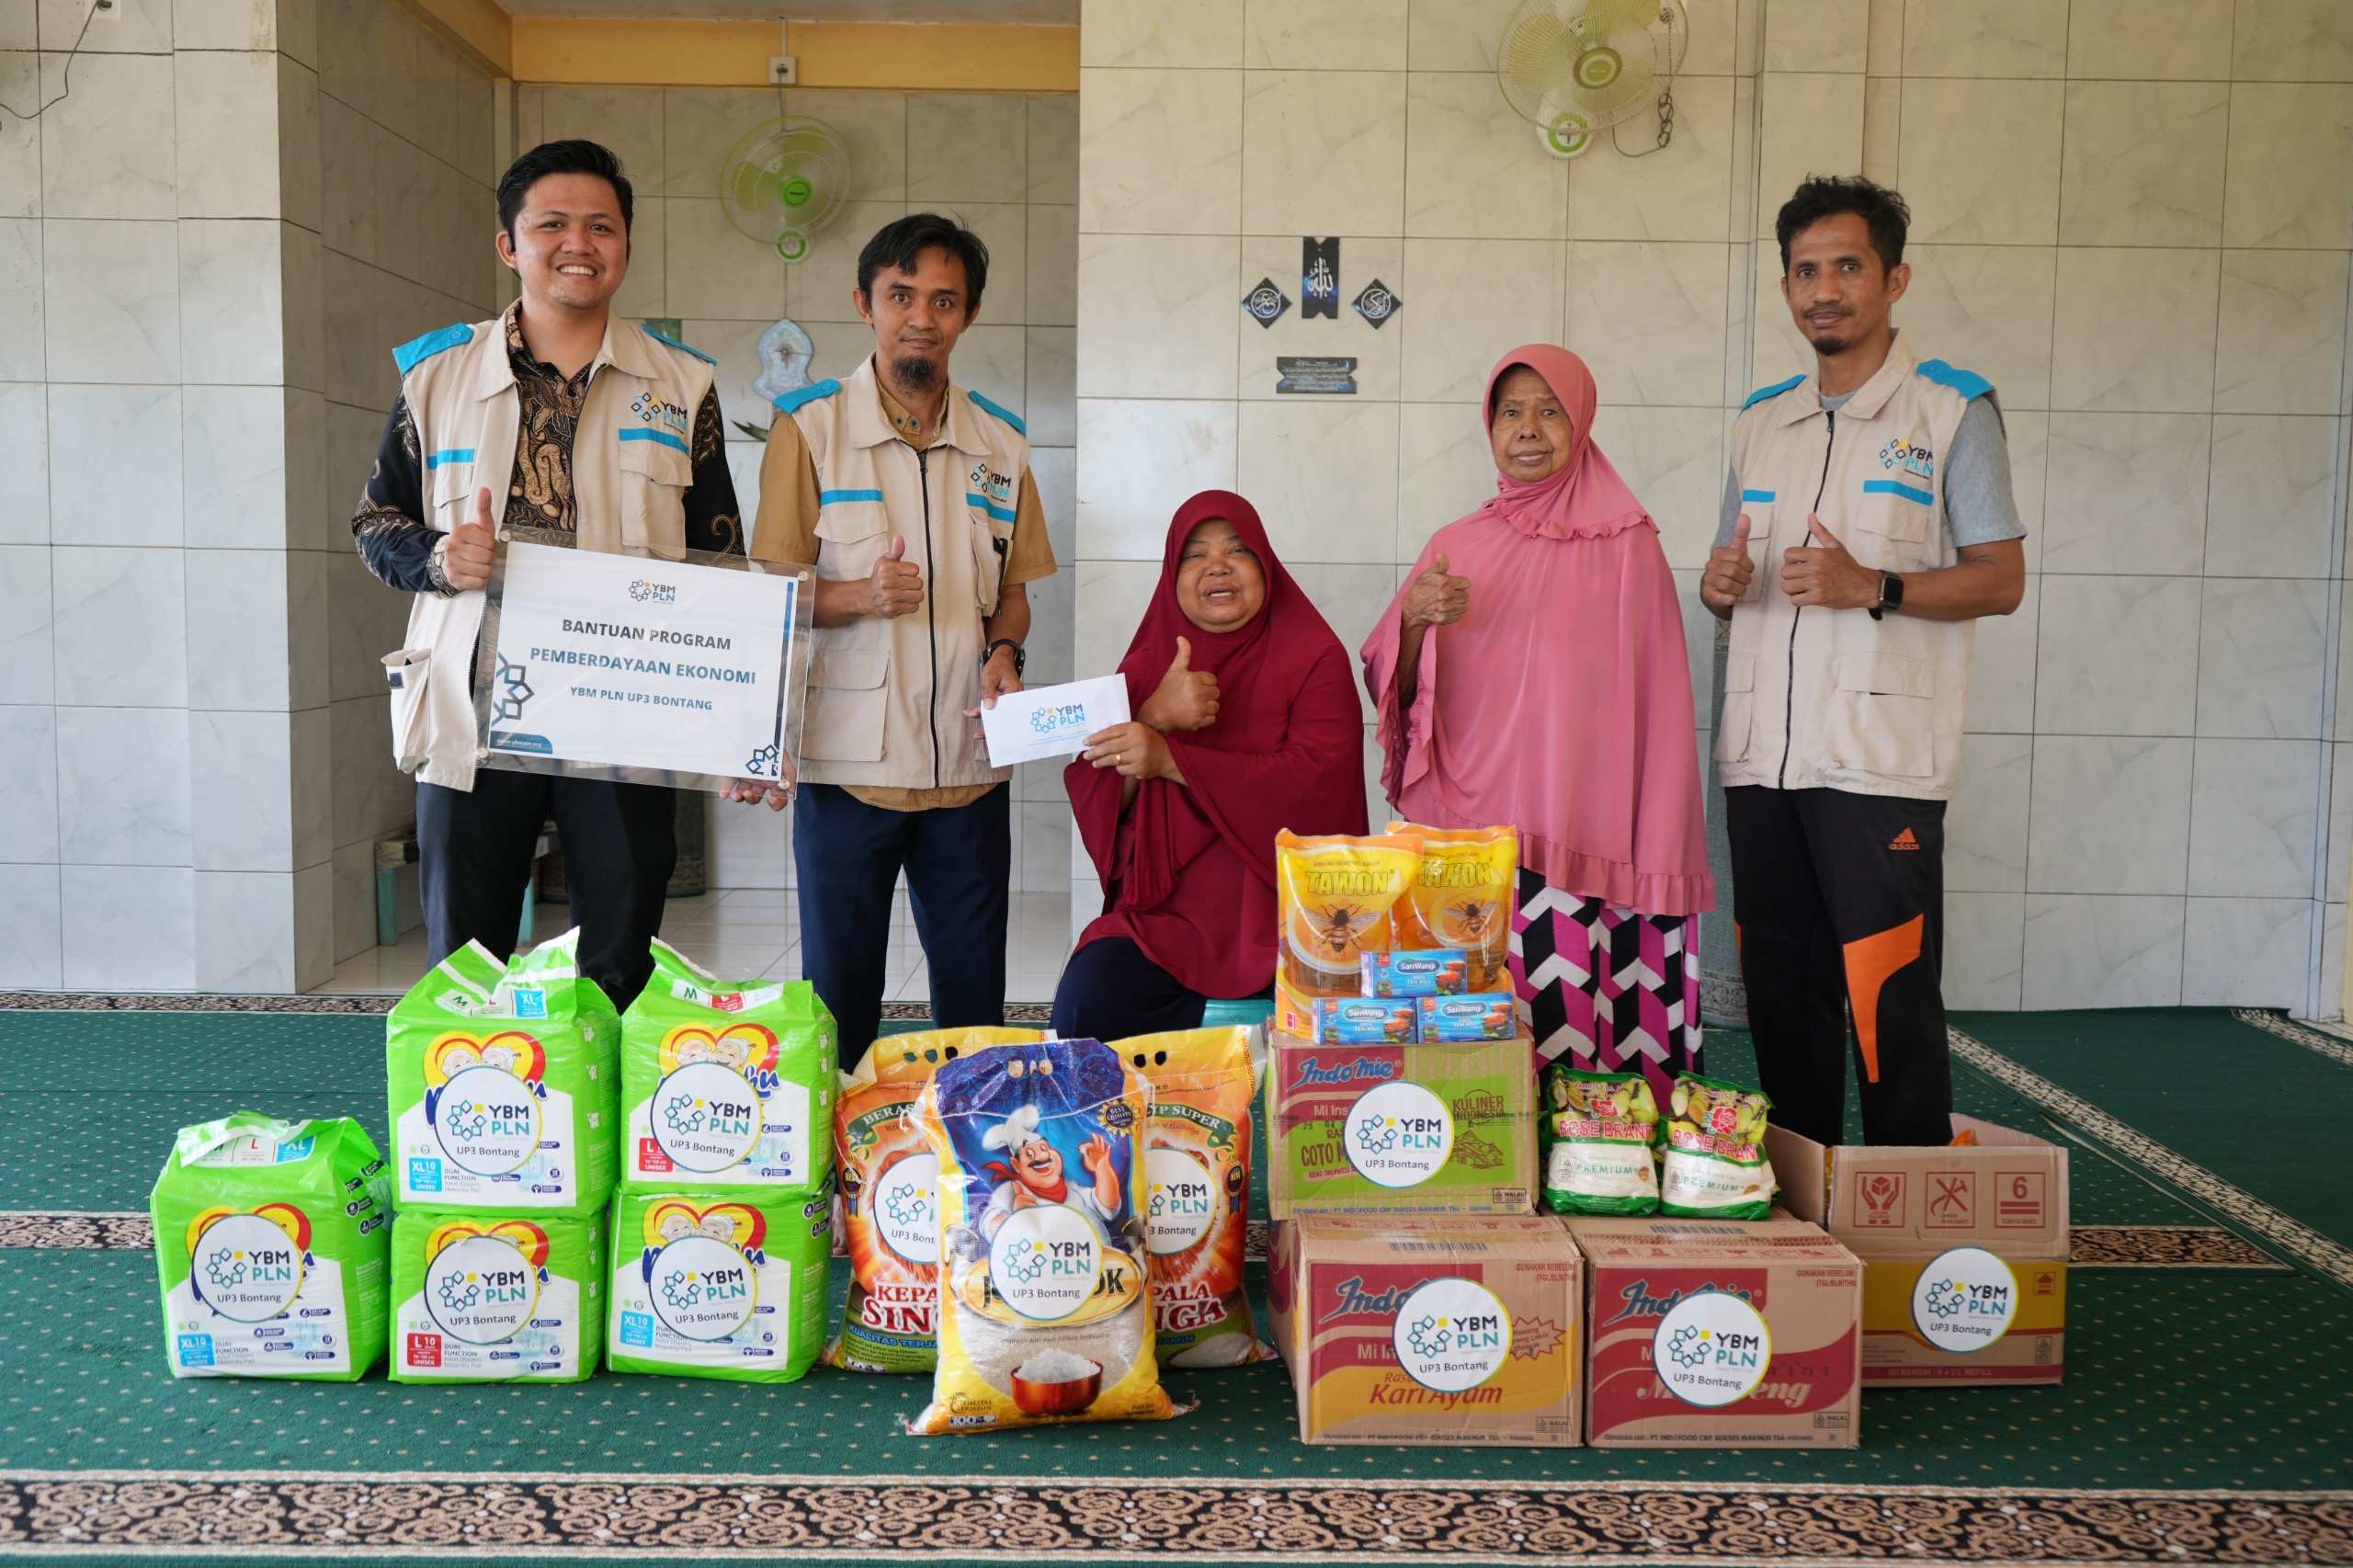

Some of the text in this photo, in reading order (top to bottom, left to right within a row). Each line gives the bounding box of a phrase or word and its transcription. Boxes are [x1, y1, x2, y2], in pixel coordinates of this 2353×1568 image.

[660, 400, 687, 419] YBM
[652, 583, 676, 594] YBM
[652, 592, 676, 602] PLN
[562, 619, 732, 650] BANTUAN PROGRAM
[529, 647, 756, 684] PEMBERDAYAAN EKONOMI
[570, 687, 712, 710] YBM PLN UP3 BONTANG
[1055, 703, 1083, 716] YBM
[1059, 712, 1086, 726] PLN
[1308, 870, 1389, 897] TAWON
[1400, 961, 1437, 971] SariWangi
[521, 992, 537, 1006] XL
[683, 987, 697, 1000] M
[1348, 1008, 1383, 1018] SariWangi
[1447, 1005, 1483, 1015] SariWangi
[710, 1101, 751, 1119] YBM
[1110, 1105, 1126, 1114] BEST
[1452, 1095, 1505, 1111] KULINER
[489, 1105, 529, 1119] YBM
[862, 1101, 915, 1126] BERAS
[1108, 1112, 1132, 1121] QUALITY
[1172, 1105, 1221, 1130] SUPER
[1313, 1105, 1349, 1117] Mi Ins
[491, 1120, 530, 1136] PLN
[710, 1119, 750, 1136] PLN
[1401, 1118, 1442, 1132] YBM
[1559, 1120, 1601, 1138] ROSE
[250, 1138, 258, 1150] L
[647, 1141, 654, 1153] L
[670, 1139, 735, 1157] UP3 Bontang
[1403, 1134, 1441, 1149] PLN
[1672, 1129, 1759, 1162] ROSE BRAN
[456, 1145, 520, 1158] UP3 Bontang
[1301, 1142, 1335, 1167] COTO
[1365, 1159, 1429, 1171] UP3 Bontang
[1575, 1164, 1633, 1176] PREMIUM
[1166, 1184, 1207, 1199] YBM
[1683, 1175, 1740, 1193] PREMIUM
[2011, 1176, 2029, 1200] 6
[1170, 1199, 1208, 1214] PLN
[892, 1230, 935, 1244] UP3 Bont
[1157, 1226, 1197, 1237] Bontang
[248, 1250, 290, 1265] YBM
[1050, 1243, 1090, 1257] YBM
[252, 1267, 291, 1281] PLN
[1051, 1259, 1090, 1275] PLN
[482, 1270, 525, 1287] YBM
[701, 1268, 744, 1285] YBM
[217, 1292, 281, 1303] UP3 Bontang
[485, 1288, 526, 1303] PLN
[706, 1284, 746, 1301] PLN
[876, 1285, 938, 1302] KEPA
[1013, 1289, 1080, 1300] UP3 Bontang
[1153, 1283, 1211, 1301] PALA
[1969, 1285, 2007, 1301] YBM
[863, 1298, 938, 1333] SIN
[1969, 1301, 2006, 1315] PLN
[450, 1314, 517, 1325] UP3 Bontang
[675, 1311, 739, 1324] UP3 Bontang
[1454, 1315, 1498, 1332] YBM
[848, 1324, 938, 1348] KUALITAS TERJA
[1930, 1323, 1993, 1336] UP3 Bontang
[415, 1336, 422, 1347] L
[1458, 1333, 1499, 1348] PLN
[1716, 1333, 1759, 1351] YBM
[1358, 1344, 1379, 1359] Mi
[1642, 1346, 1653, 1360] M
[1419, 1361, 1489, 1373] UP3 Bontang
[1715, 1352, 1757, 1368] PLN
[1674, 1373, 1743, 1391] UP3 Bontang
[1369, 1382, 1504, 1411] Kari Ayam
[1751, 1381, 1812, 1409] eng
